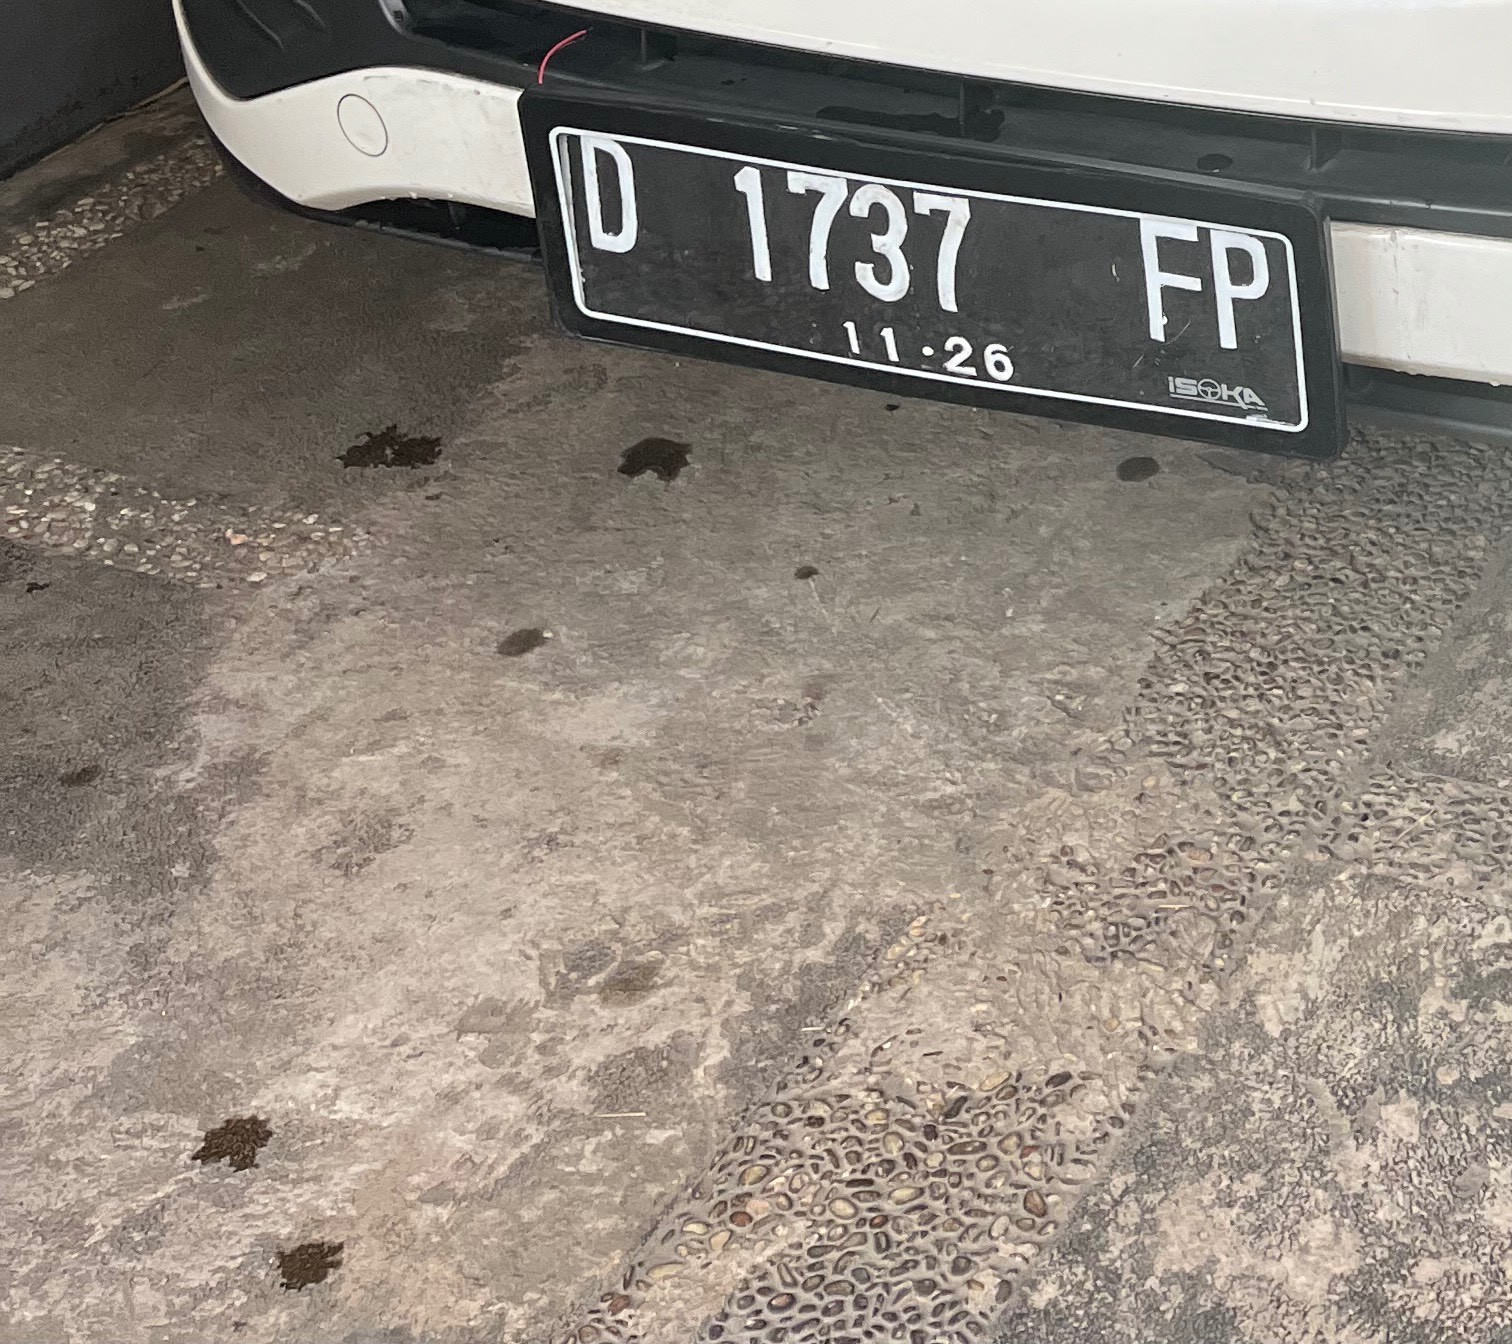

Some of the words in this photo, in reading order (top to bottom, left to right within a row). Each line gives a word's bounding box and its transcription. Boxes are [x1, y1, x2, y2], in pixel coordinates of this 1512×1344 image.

[580, 135, 637, 254] D
[733, 165, 970, 313] 1737
[1139, 217, 1269, 350] FP
